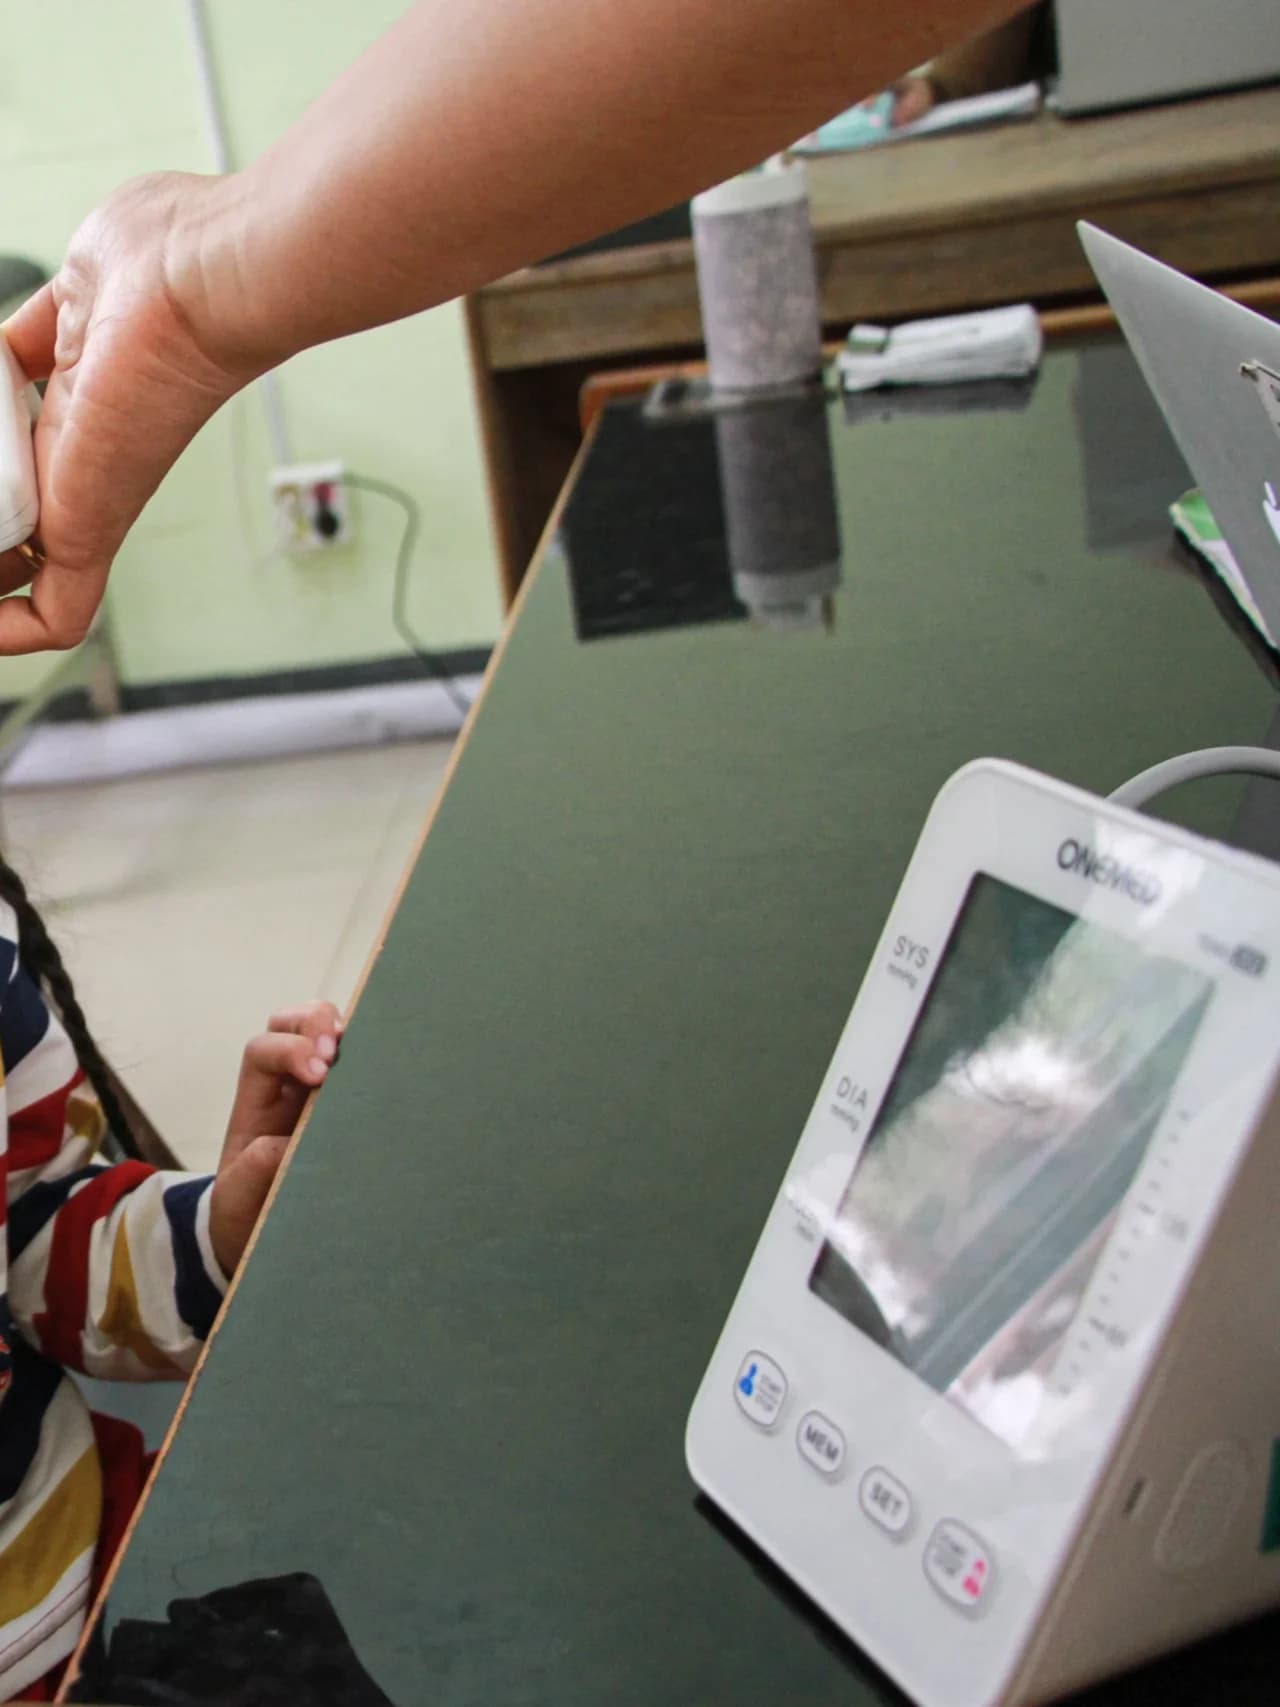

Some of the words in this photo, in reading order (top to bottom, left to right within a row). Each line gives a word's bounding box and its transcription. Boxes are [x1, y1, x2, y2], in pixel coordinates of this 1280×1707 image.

[893, 935, 929, 969] SYS
[836, 1076, 867, 1111] DIA
[805, 1424, 839, 1461] MEM
[870, 1482, 901, 1517] SET
